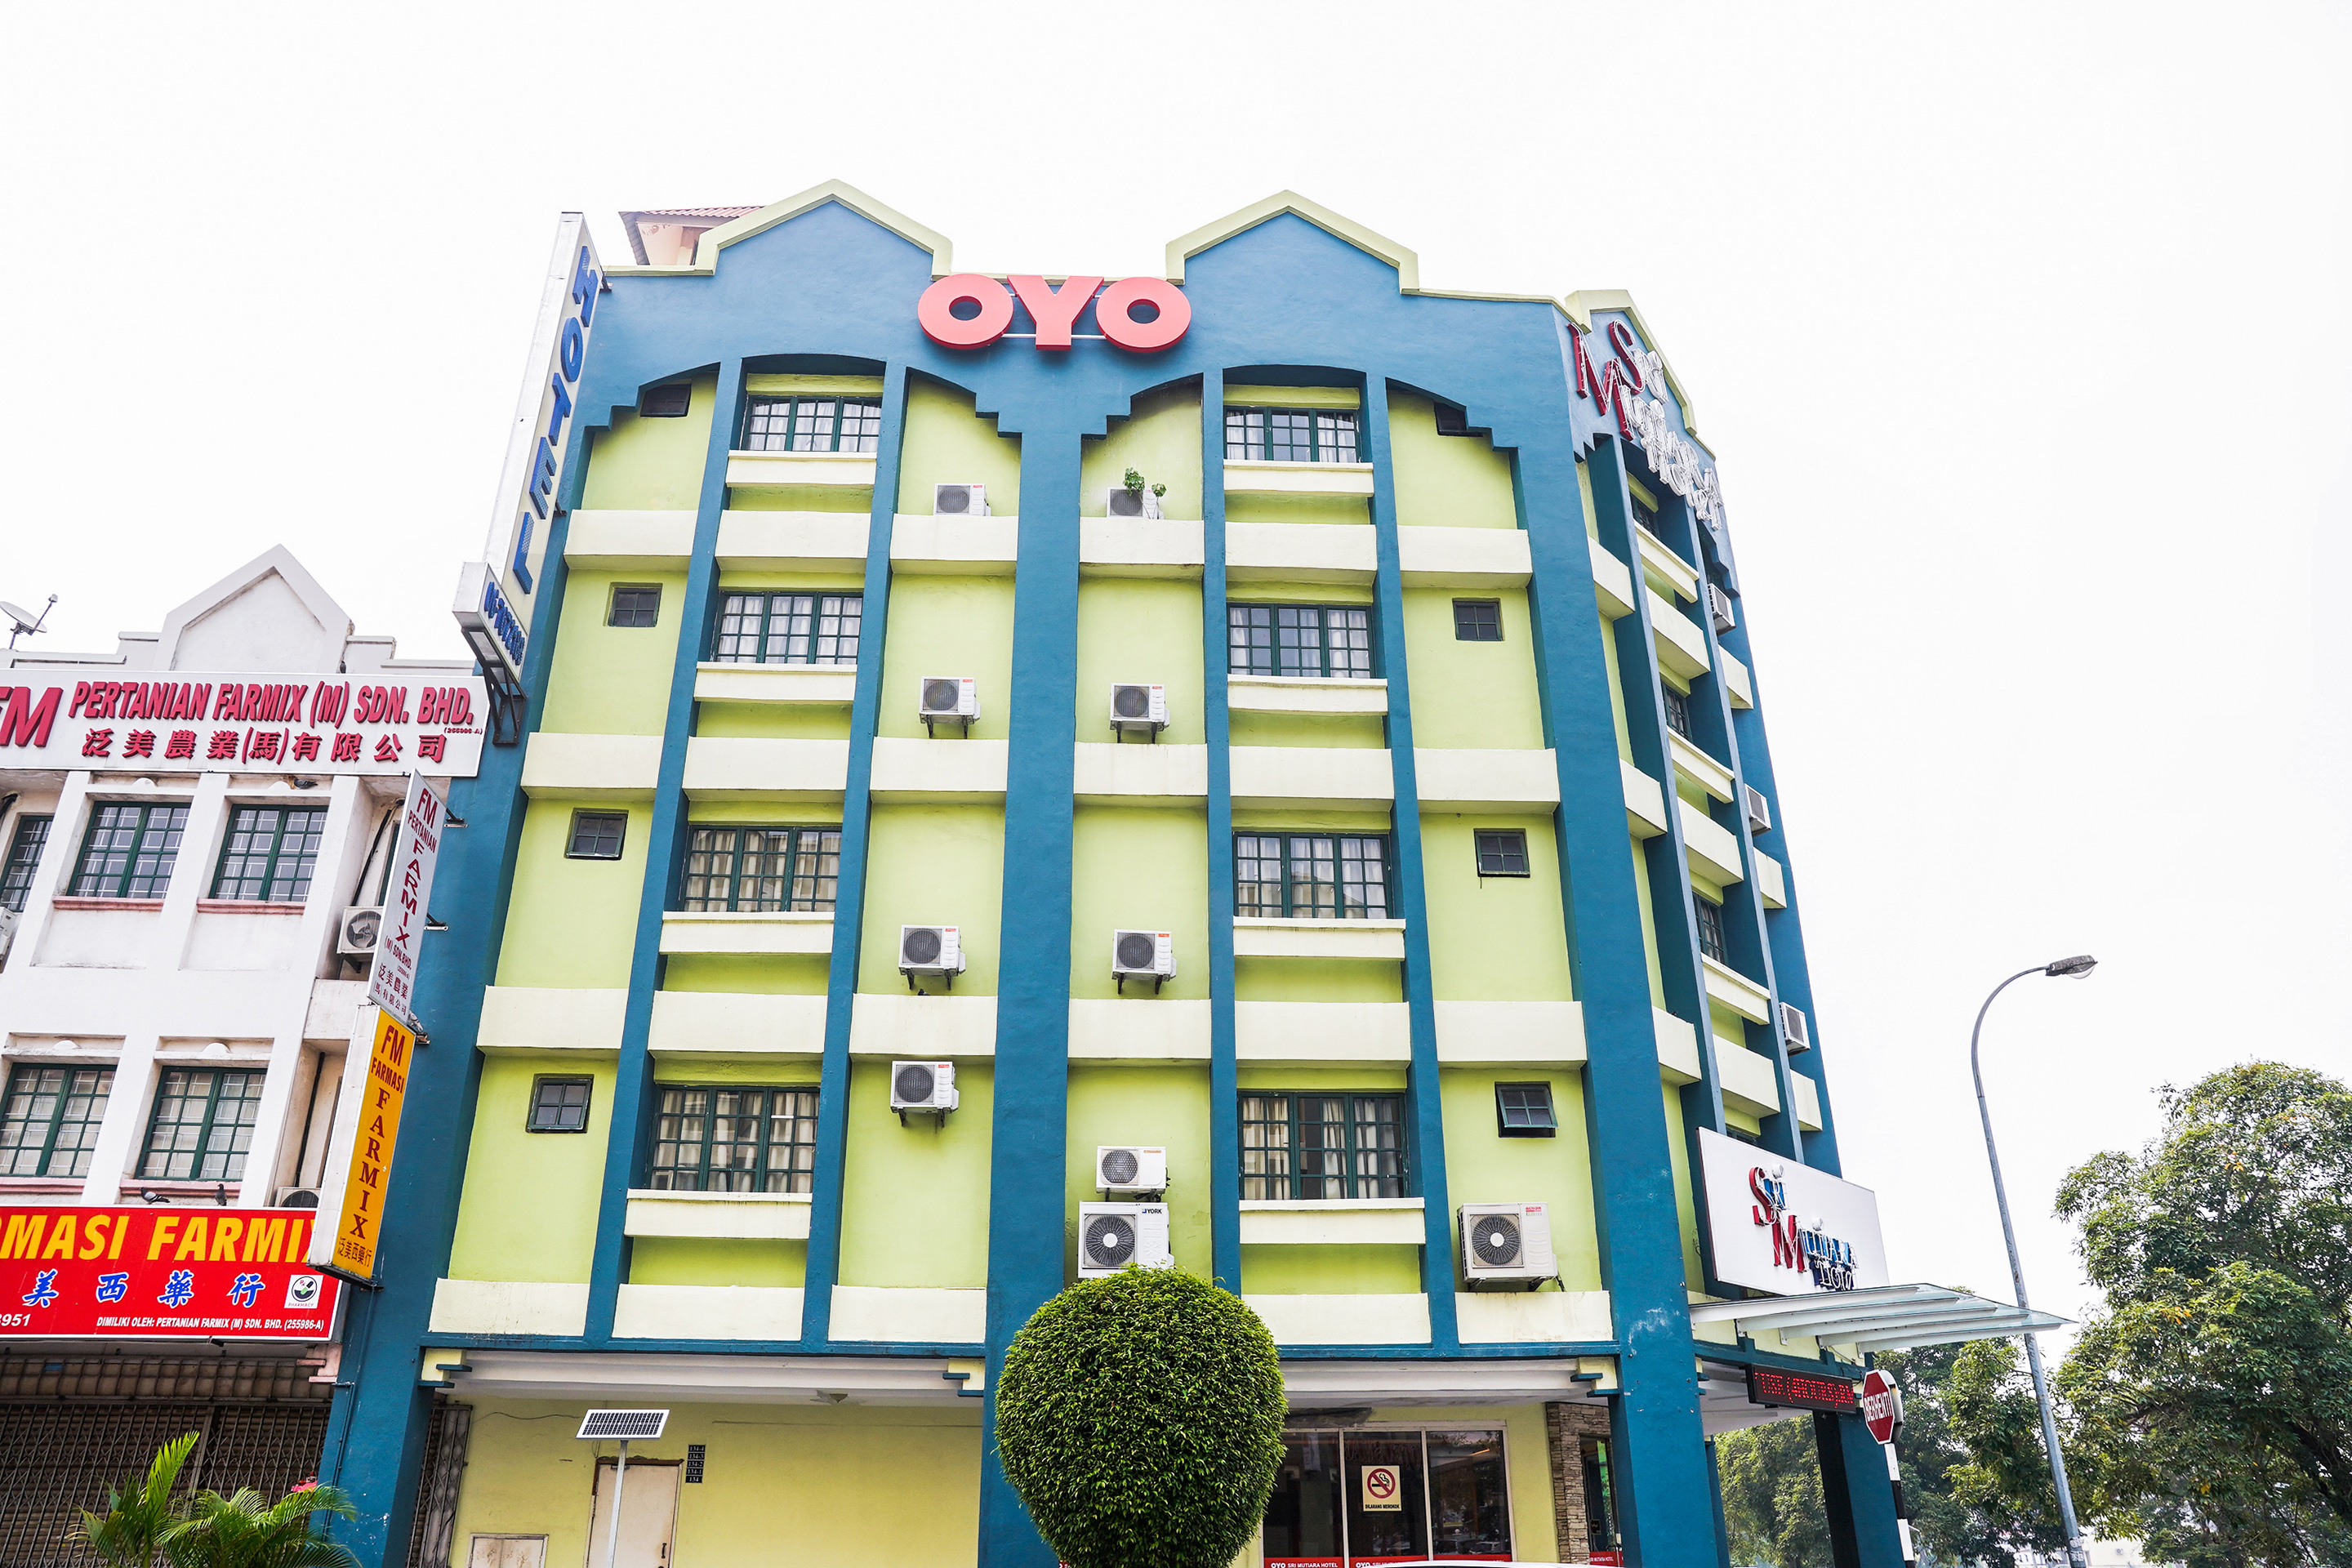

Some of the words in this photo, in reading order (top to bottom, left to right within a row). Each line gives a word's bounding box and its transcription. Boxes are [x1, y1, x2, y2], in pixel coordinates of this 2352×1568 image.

[918, 274, 1192, 353] OYO
[513, 246, 598, 595] HOTEL
[68, 681, 212, 720] PERTANIAN
[212, 683, 308, 723] FARMIX
[310, 680, 350, 729] (M)
[354, 685, 409, 724] SDN.
[416, 687, 474, 725] BHD.
[416, 787, 438, 829] FM
[408, 810, 437, 853] PERTANIAN
[395, 838, 425, 950] FARMIX
[381, 1024, 405, 1067] FM
[371, 1056, 405, 1094] FARMASI
[350, 1087, 390, 1240] FARMIX
[0, 1214, 130, 1260] MASI
[96, 1316, 130, 1326] DIMILIKI
[131, 1317, 155, 1327] OLEH:
[156, 1317, 200, 1328] PERTANIAN
[201, 1318, 229, 1328] FARMIX
[230, 1318, 243, 1330] (M)
[245, 1319, 262, 1329] SDN.
[264, 1319, 283, 1329] BHD.
[283, 1319, 324, 1331] (255986-A)
[1864, 1391, 1892, 1422] BERHENTI
